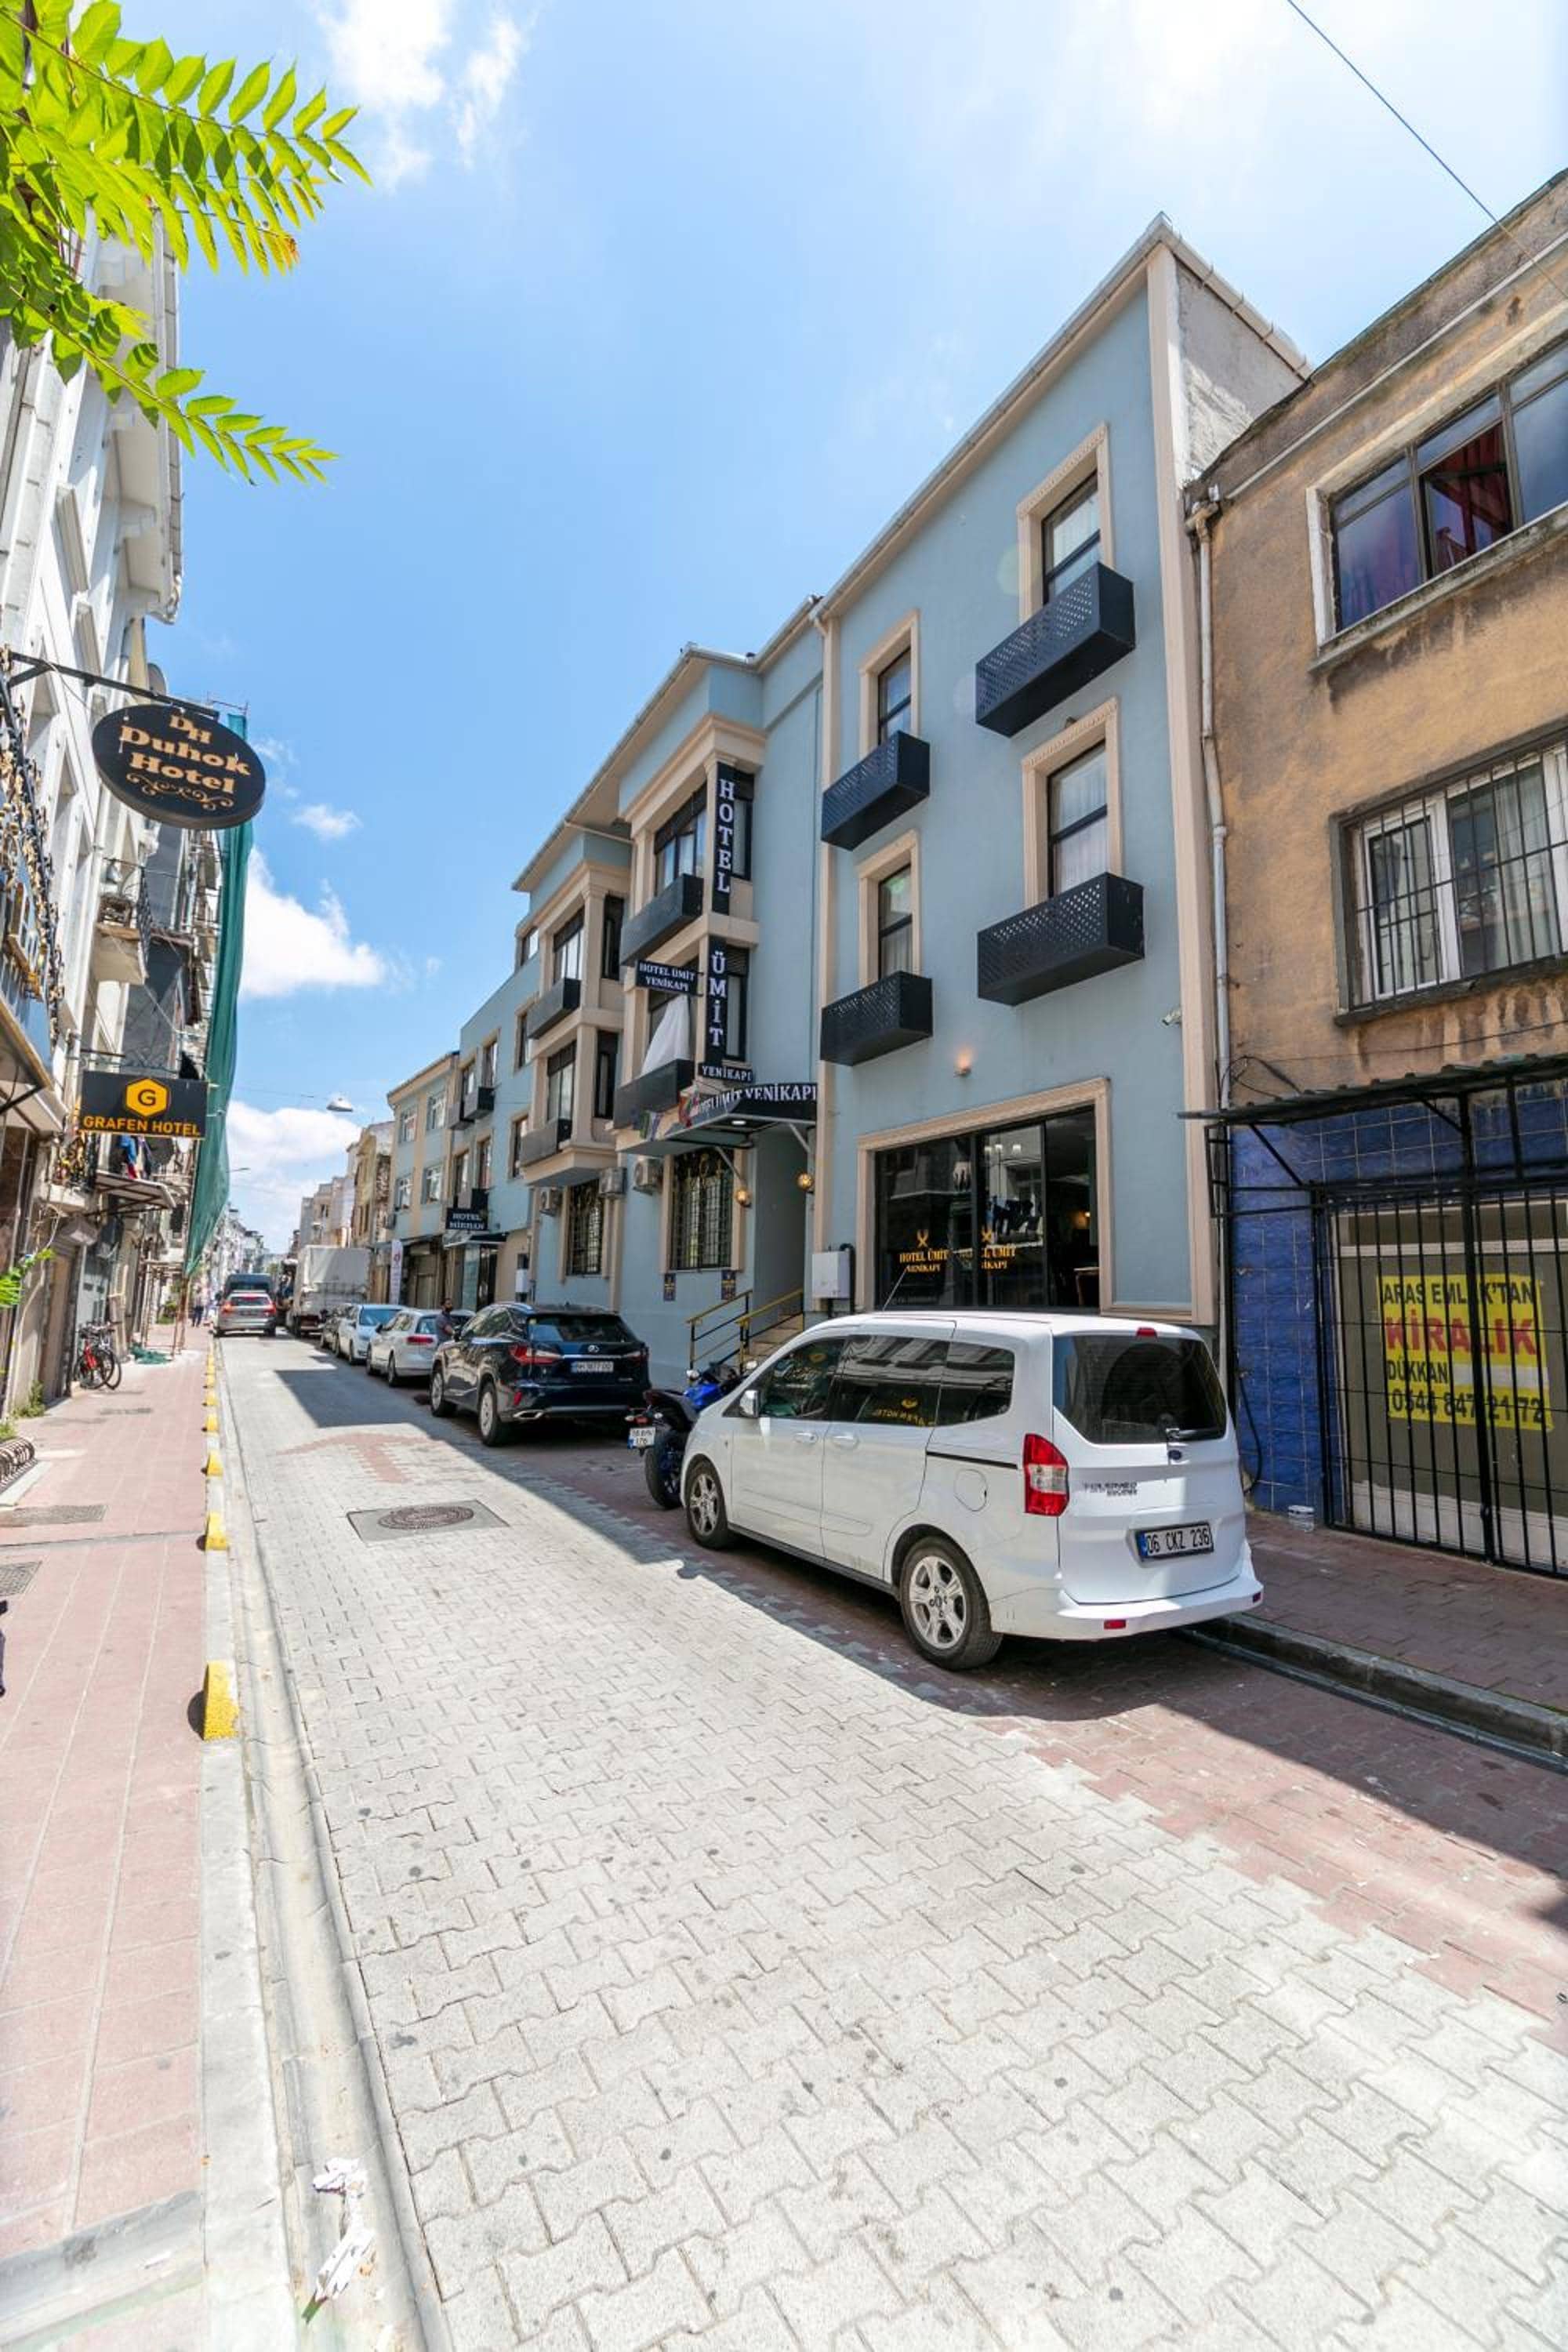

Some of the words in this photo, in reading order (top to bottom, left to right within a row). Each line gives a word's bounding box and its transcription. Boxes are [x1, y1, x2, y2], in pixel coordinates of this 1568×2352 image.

[120, 725, 251, 775] Duhok
[129, 751, 235, 794] Hotel
[716, 779, 735, 894] HOTEL
[639, 962, 670, 976] HOTEL
[709, 950, 728, 1047] ÜMİT
[702, 1065, 752, 1082] YENİKAPI
[137, 1088, 157, 1106] G
[744, 1083, 817, 1102] YENİKAPI
[83, 1116, 148, 1131] GRAFEN
[152, 1121, 201, 1136] HOTEL
[1383, 1283, 1425, 1305] ARAS
[1387, 1356, 1450, 1385] DÜKKAN
[1146, 1533, 1161, 1554] 06
[1166, 1530, 1186, 1551] CKZ
[1190, 1528, 1210, 1547] 236
